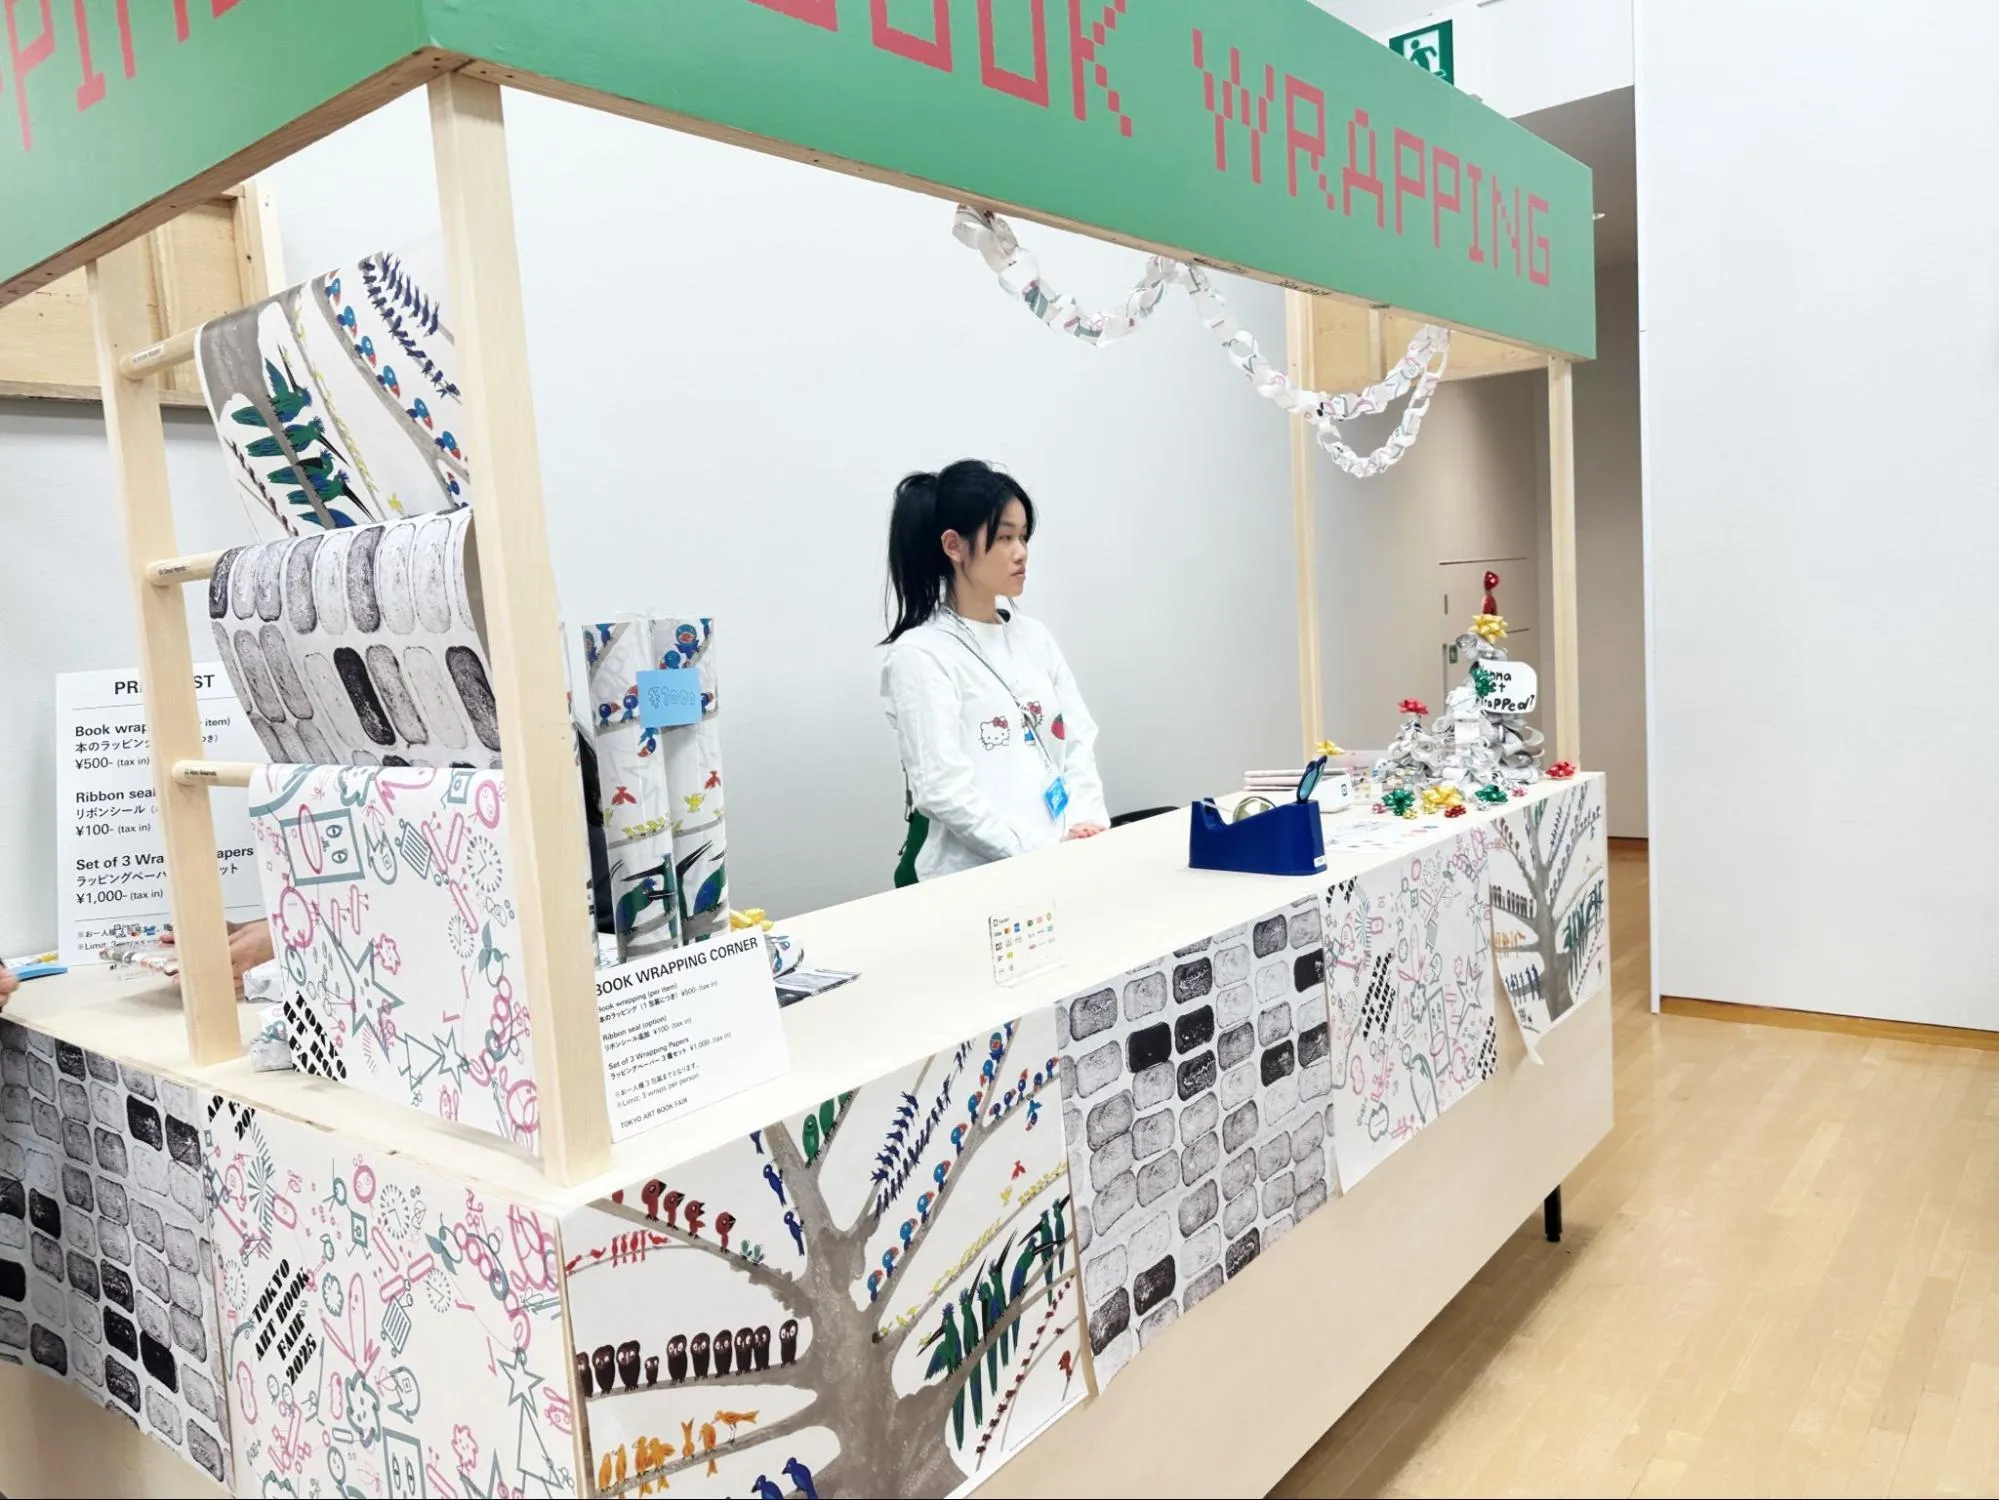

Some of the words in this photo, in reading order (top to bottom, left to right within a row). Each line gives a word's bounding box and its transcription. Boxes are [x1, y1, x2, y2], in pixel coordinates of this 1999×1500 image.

[1192, 28, 1550, 288] WRAPPING
[75, 724, 110, 737] Book
[75, 756, 113, 770] ¥500-
[117, 758, 135, 767] (tax
[138, 757, 150, 766] in)
[76, 790, 124, 803] Ribbon
[129, 788, 155, 799] seal
[76, 806, 145, 819] リボンシール
[76, 823, 114, 837] ¥100-
[118, 825, 136, 834] (tax
[139, 823, 151, 832] in)
[76, 859, 100, 871] Set
[103, 856, 118, 868] of
[122, 855, 131, 866] 3
[216, 846, 254, 860] apers
[76, 890, 127, 904] ¥1,000-
[130, 891, 149, 901] (tax
[151, 889, 164, 899] in)
[635, 952, 707, 984] WRAPPING
[709, 937, 759, 961] CORNER
[1361, 955, 1382, 1015] TOKYO
[615, 993, 647, 1008] wrapping
[296, 990, 347, 1080] TOKYO
[602, 1028, 627, 1042] Ribbon
[628, 1024, 641, 1034] seal
[642, 1015, 667, 1030] (option)
[608, 1060, 620, 1071] Set
[621, 1057, 629, 1067] of
[635, 1045, 668, 1061] Wrapping
[668, 1037, 689, 1051] Papers
[648, 1085, 667, 1097] wraps
[668, 1081, 678, 1091] per
[620, 1115, 642, 1129] TOKYO
[643, 1109, 656, 1120] ART
[656, 1103, 674, 1115] BOOK
[674, 1097, 688, 1107] FAIR
[252, 1258, 290, 1323] TOKYO
[255, 1318, 277, 1362] ART
[275, 1266, 310, 1324] BOOK
[277, 1312, 305, 1361] FAIR
[286, 1332, 317, 1387] 2025
